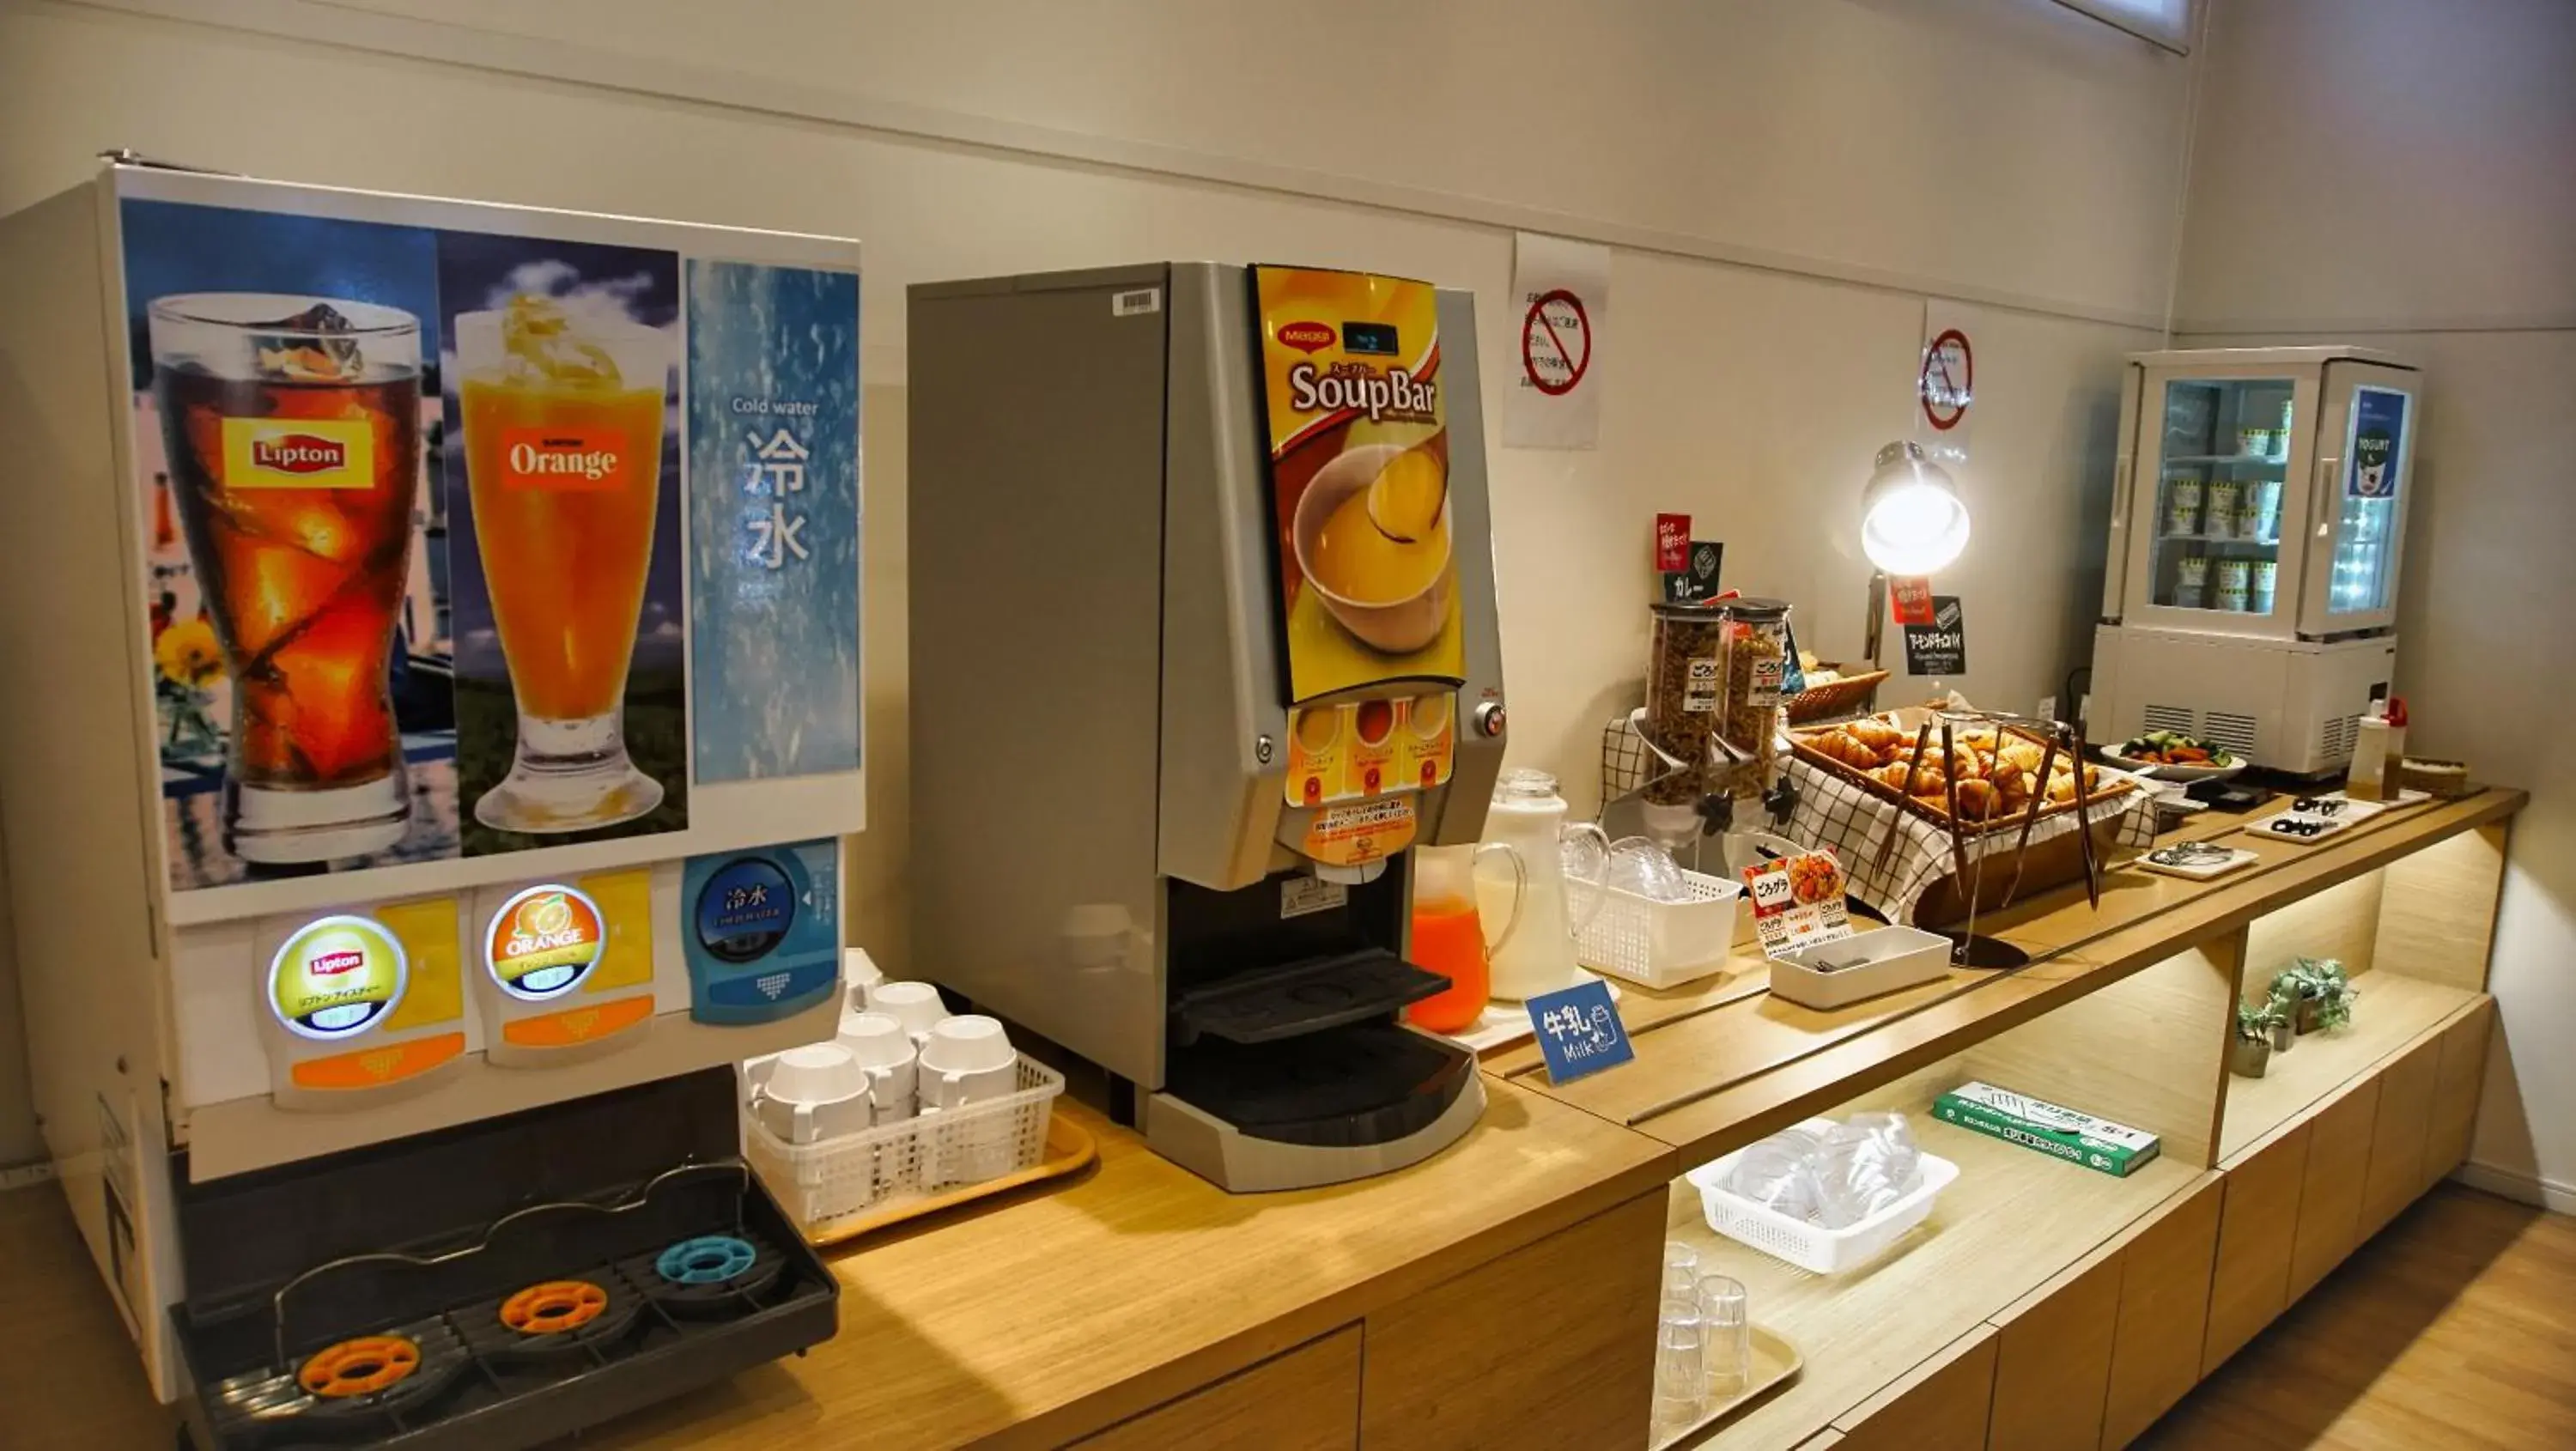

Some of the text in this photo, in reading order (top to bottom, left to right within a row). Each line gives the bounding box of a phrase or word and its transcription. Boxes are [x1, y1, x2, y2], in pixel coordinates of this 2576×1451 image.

[732, 398, 819, 416] Cold water
[259, 443, 341, 466] Lipton
[510, 442, 618, 480] Orange
[743, 429, 810, 568] 冷水
[1674, 576, 1704, 598] カレー
[726, 884, 769, 911] 冷水
[1757, 877, 1789, 897] ごろグラ
[505, 926, 585, 956] ORANGE
[313, 954, 360, 973] Lipton
[1542, 1005, 1592, 1041] 牛乳
[1563, 1040, 1595, 1063] Milk
